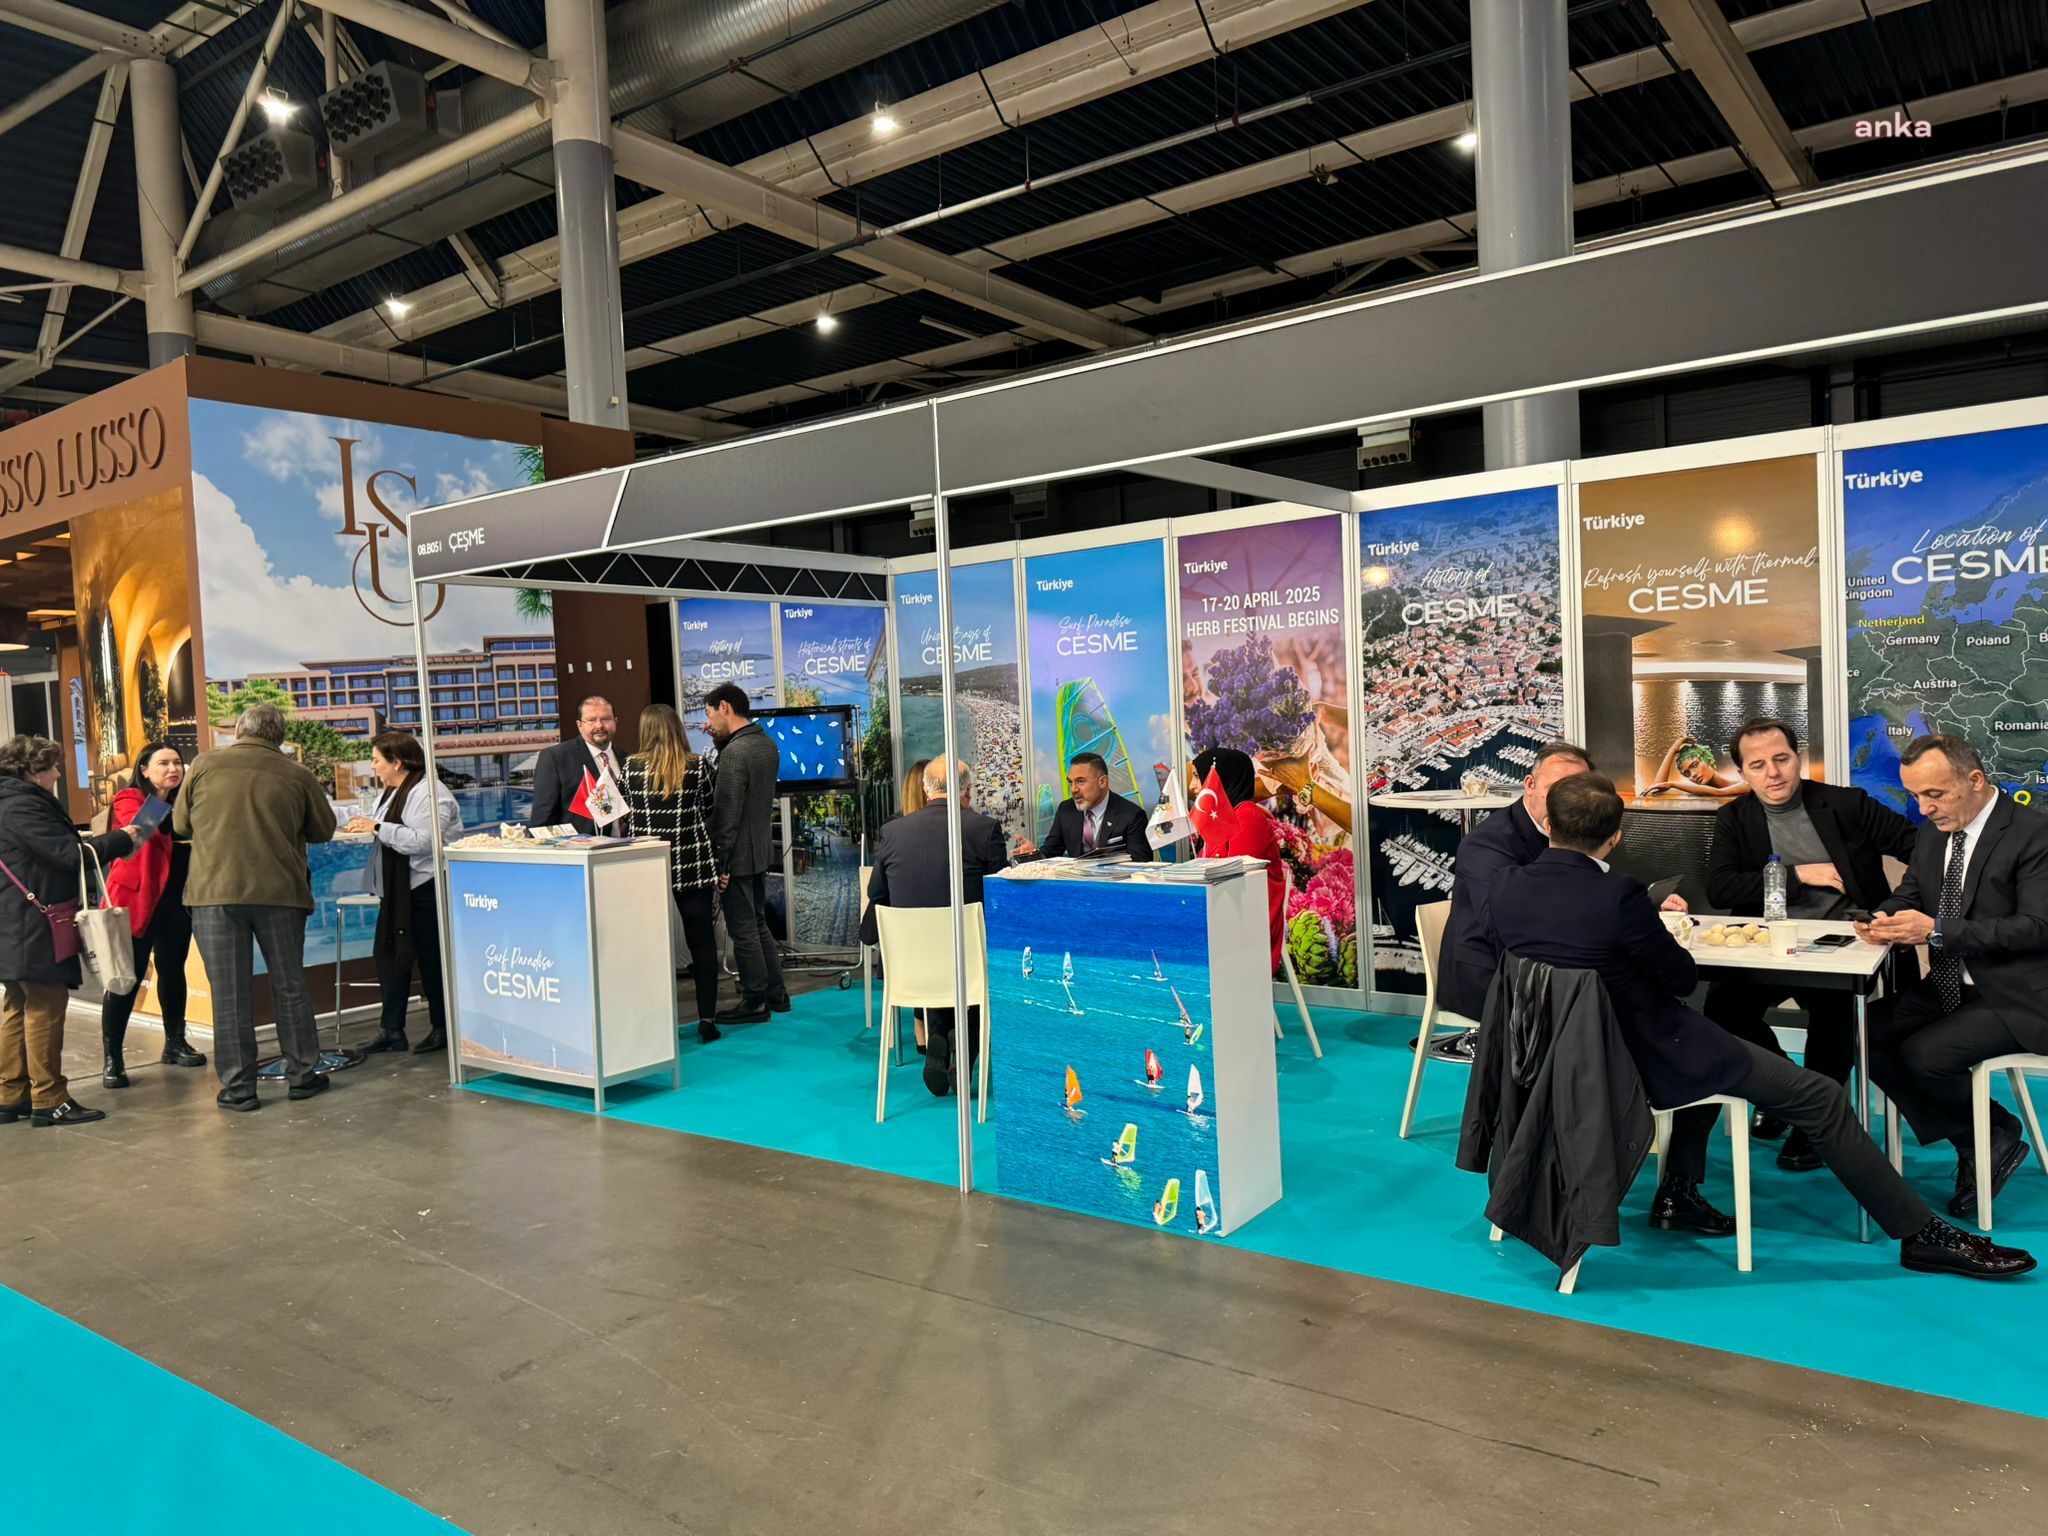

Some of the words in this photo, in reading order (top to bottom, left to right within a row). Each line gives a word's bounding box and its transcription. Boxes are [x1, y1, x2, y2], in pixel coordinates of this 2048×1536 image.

[56, 405, 166, 499] LUSSO
[1844, 468, 1924, 490] Türkiye
[1583, 512, 1646, 531] Türkiye
[448, 527, 486, 553] ÇEŞME
[1912, 523, 2015, 554] Location
[2018, 518, 2048, 546] of
[1367, 540, 1420, 557] Türkiye
[1184, 559, 1228, 574] Türkiye
[1420, 566, 1472, 589] History
[1475, 562, 1494, 582] of
[1583, 564, 1643, 590] Refresh
[1646, 556, 1712, 586] yourself
[1714, 554, 1747, 578] with
[1749, 546, 1818, 577] thermal
[1036, 578, 1074, 592] Türkiye
[1847, 575, 1885, 587] United
[900, 592, 933, 606] Türkiye
[1202, 594, 1240, 613] 17-20
[1243, 590, 1283, 609] APRIL
[1285, 586, 1321, 605] 2025
[1628, 578, 1769, 614] CESME
[784, 607, 814, 619] Türkiye
[1401, 593, 1518, 626] CESME
[683, 620, 709, 632] Türkiye
[1058, 616, 1084, 638] Surf
[1086, 611, 1133, 632] Paradise
[1186, 620, 1221, 638] HERB
[1224, 614, 1285, 634] FESTIVAL
[1288, 608, 1340, 628] BEGINS
[1858, 614, 1925, 628] Netherland
[982, 624, 991, 643] of
[1886, 633, 1941, 648] Germany
[1966, 634, 2010, 647] Poland
[798, 637, 838, 658] Historical
[1056, 631, 1139, 657] CESME
[700, 659, 755, 679] CESME
[804, 654, 867, 675] CESME
[1913, 678, 1957, 690] Austria
[1888, 726, 1913, 737] Italy
[1994, 720, 2048, 731] Romania
[463, 893, 499, 911] Türkiye
[485, 944, 509, 972] Surf
[510, 946, 554, 972] Paradise
[483, 970, 561, 1003] CESME
